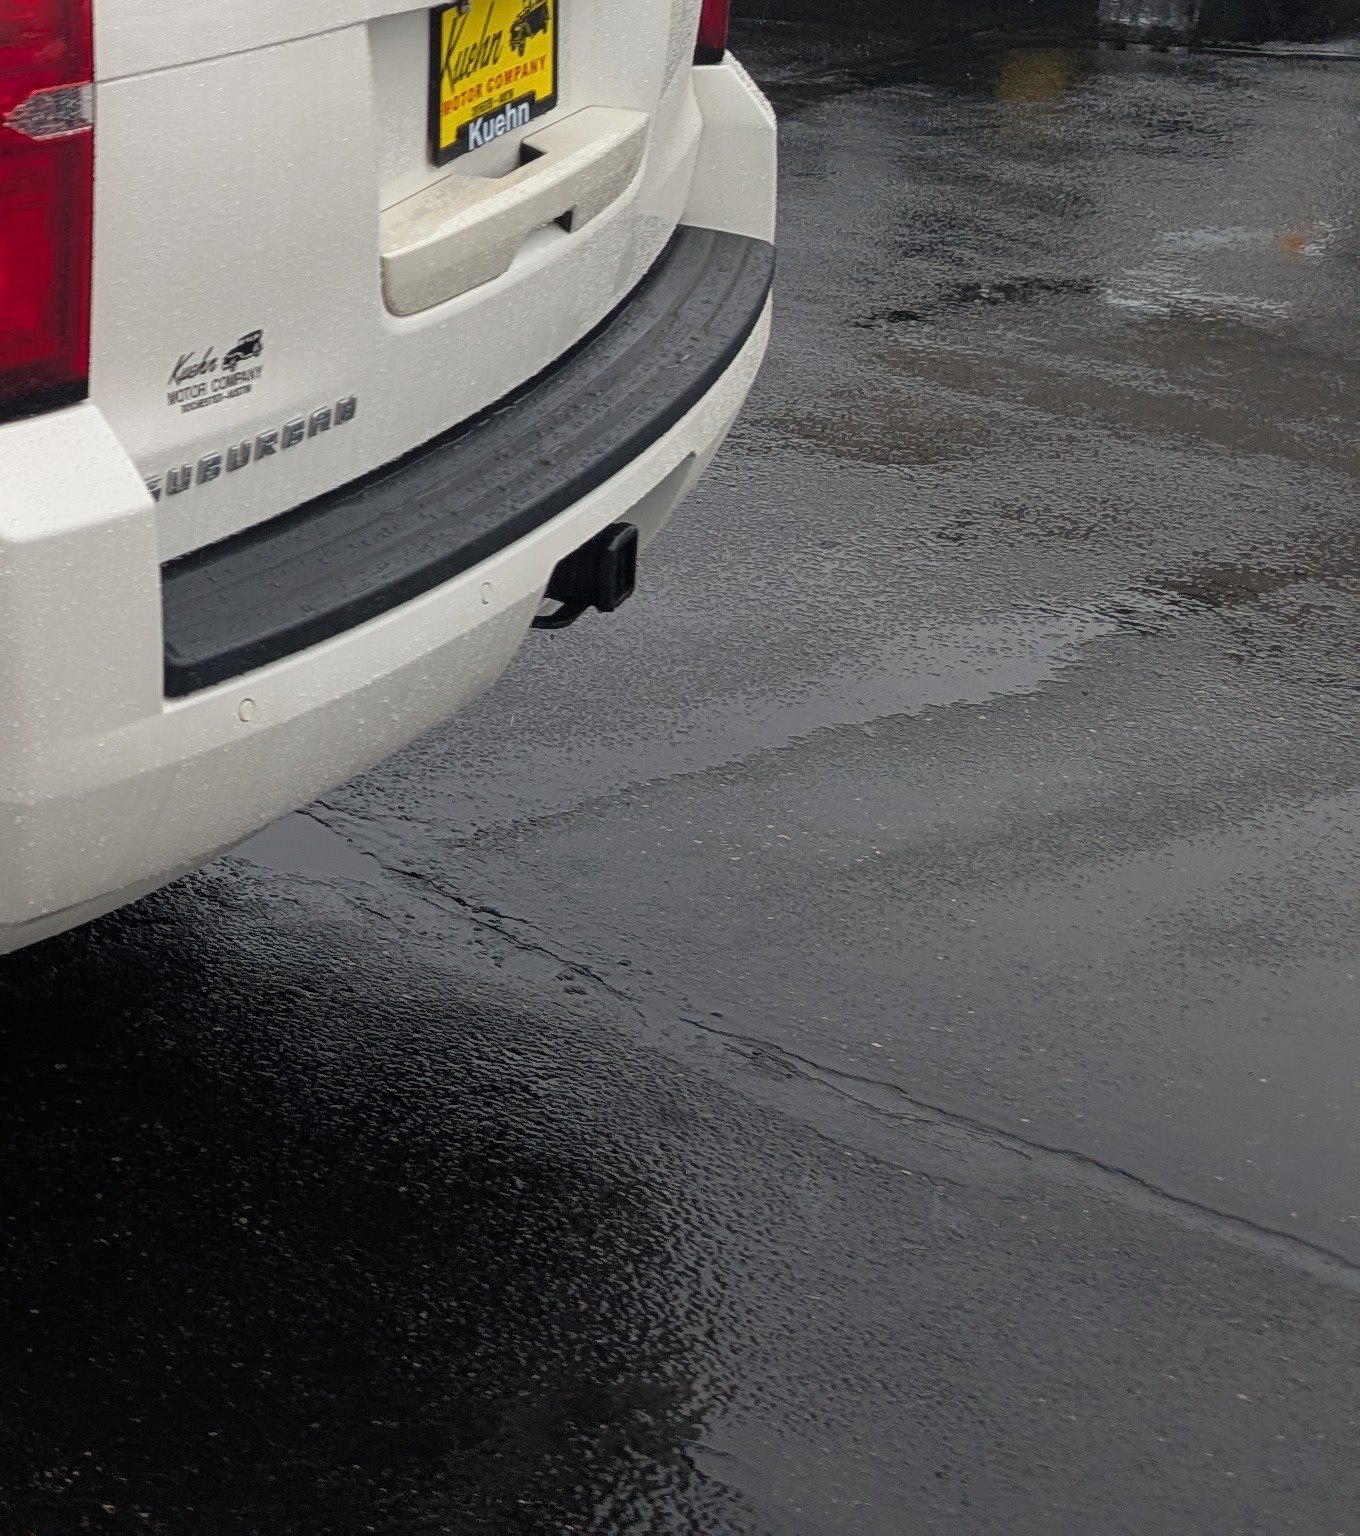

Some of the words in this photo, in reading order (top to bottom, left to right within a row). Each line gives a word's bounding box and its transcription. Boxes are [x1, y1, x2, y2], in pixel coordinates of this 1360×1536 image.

[440, 0, 504, 93] Kuehn
[442, 82, 483, 116] MOTOR
[486, 54, 548, 94] COMPANY
[468, 100, 531, 151] Kuehn
[166, 346, 219, 386] Kuehn
[167, 382, 208, 406] MOTOR
[211, 365, 264, 393] COMPANY
